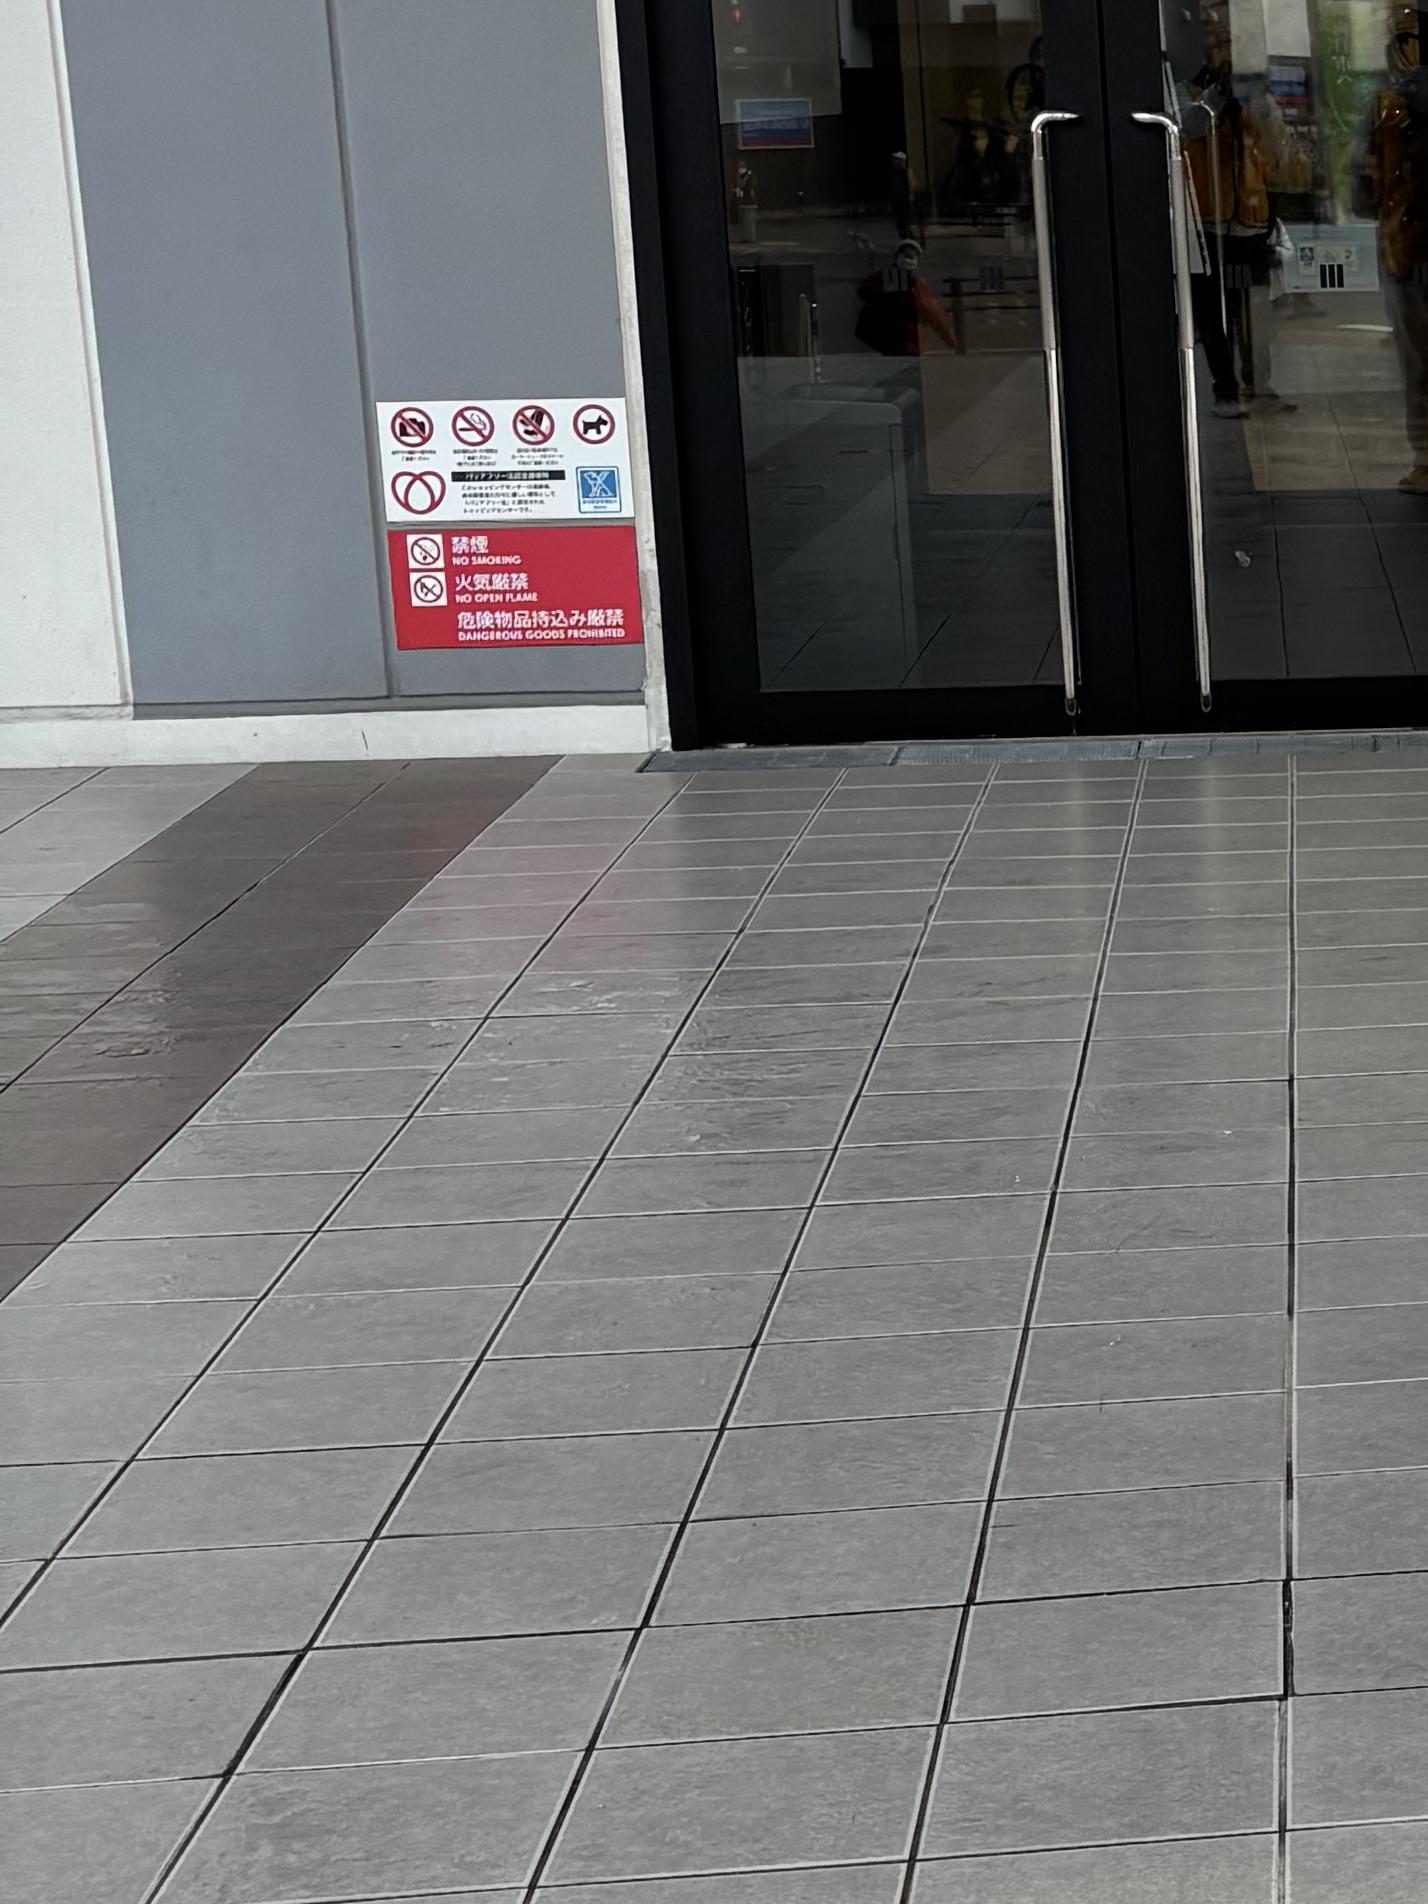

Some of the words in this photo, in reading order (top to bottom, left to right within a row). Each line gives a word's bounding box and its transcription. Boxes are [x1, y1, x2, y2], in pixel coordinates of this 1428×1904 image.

[451, 535, 489, 554] 禁煙
[452, 556, 469, 565] NO
[471, 555, 522, 565] SMOKING
[455, 572, 528, 591] 火気厳禁
[455, 594, 472, 603] NO
[474, 593, 504, 603] OPEN
[505, 592, 538, 602] FLAME
[457, 608, 624, 629] 危険物品持込み厳禁
[458, 630, 523, 641] DANGEROUS
[525, 629, 565, 640] GOODS
[567, 628, 625, 639] PROHIBITED
